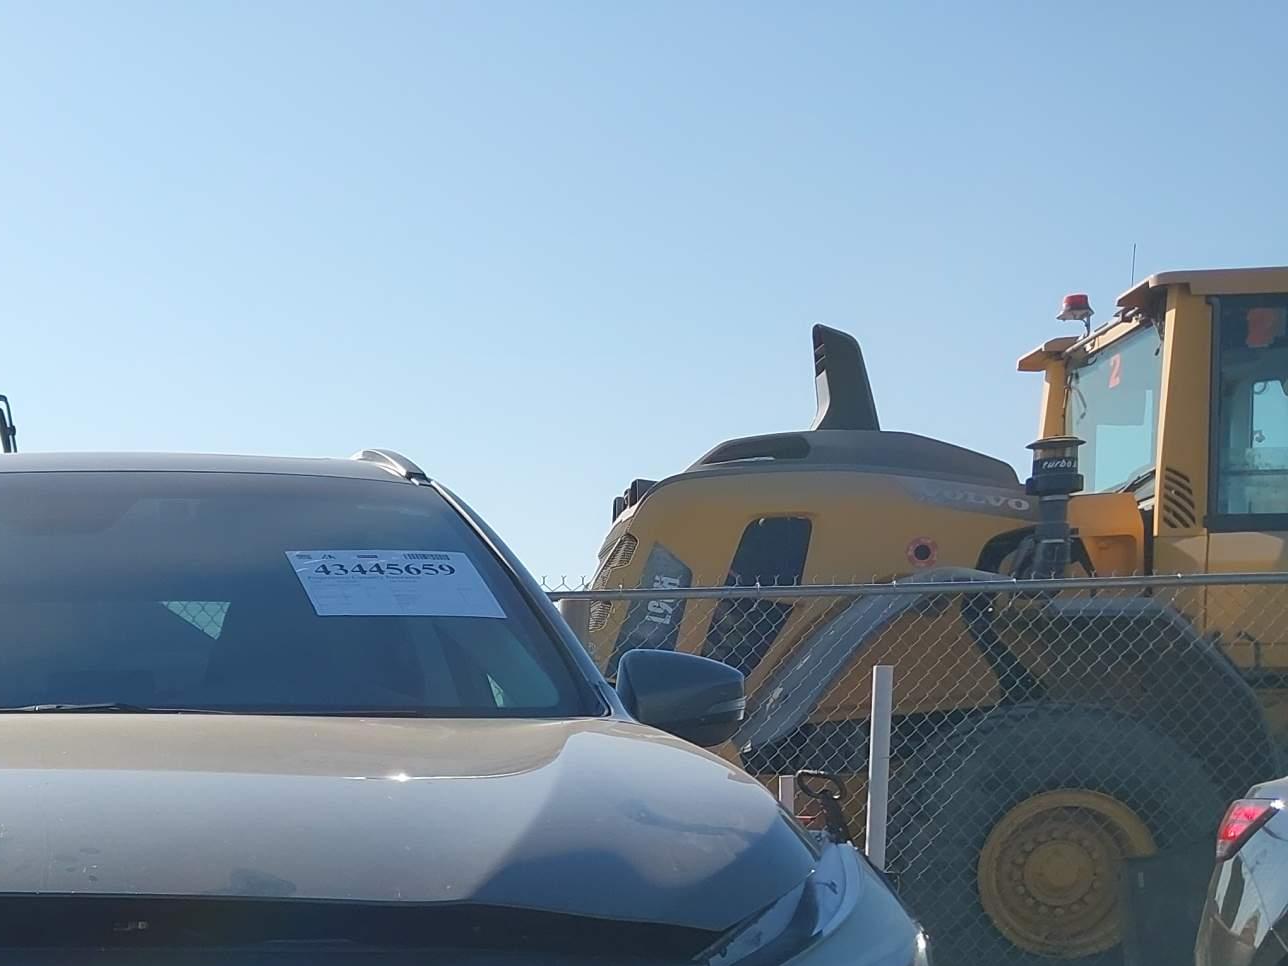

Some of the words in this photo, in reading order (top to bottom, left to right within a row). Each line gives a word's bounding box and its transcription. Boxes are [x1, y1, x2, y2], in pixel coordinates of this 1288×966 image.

[1107, 352, 1121, 390] 2
[314, 562, 457, 577] 43445659
[645, 575, 680, 625] L9H
